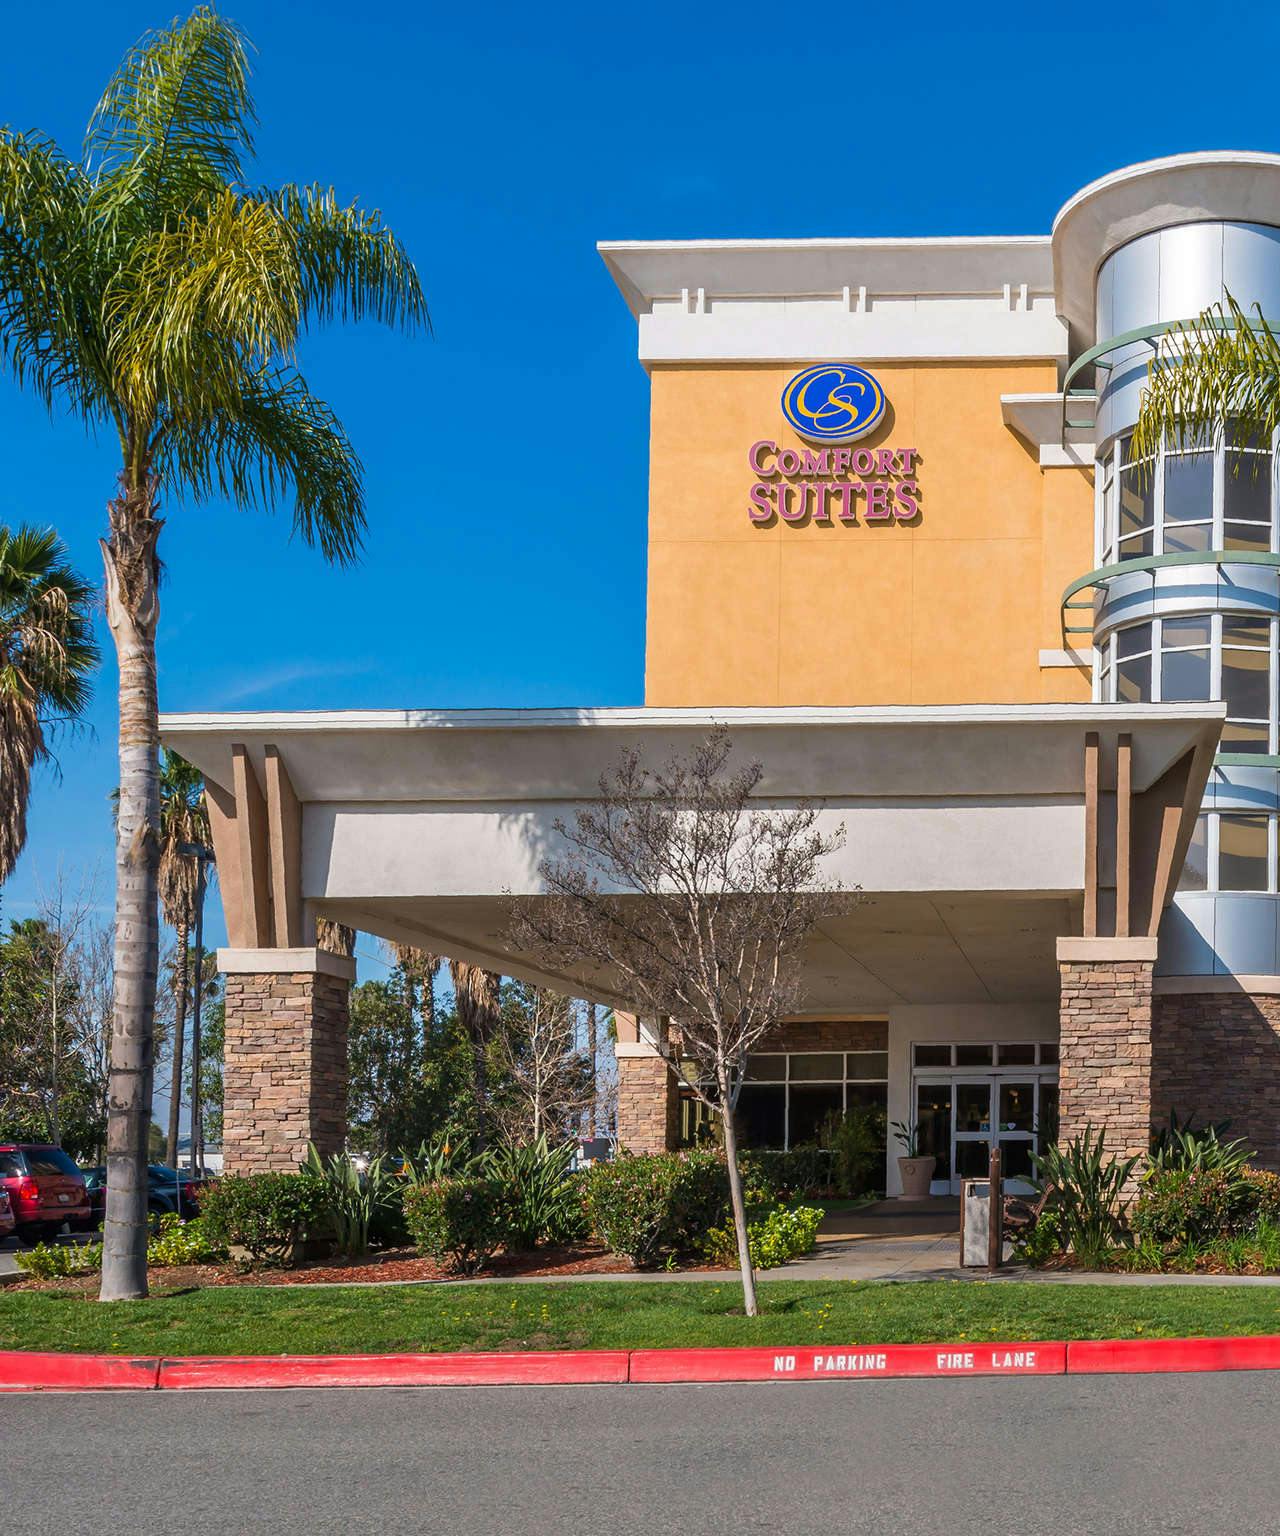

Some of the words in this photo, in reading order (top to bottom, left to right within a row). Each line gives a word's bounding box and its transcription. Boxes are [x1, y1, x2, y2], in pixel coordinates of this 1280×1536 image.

[749, 440, 917, 476] COMFORT
[748, 481, 918, 521] SUITES
[774, 1356, 796, 1372] NO
[813, 1354, 887, 1371] PARKING
[937, 1353, 974, 1369] FIRE
[992, 1352, 1035, 1368] LANE
